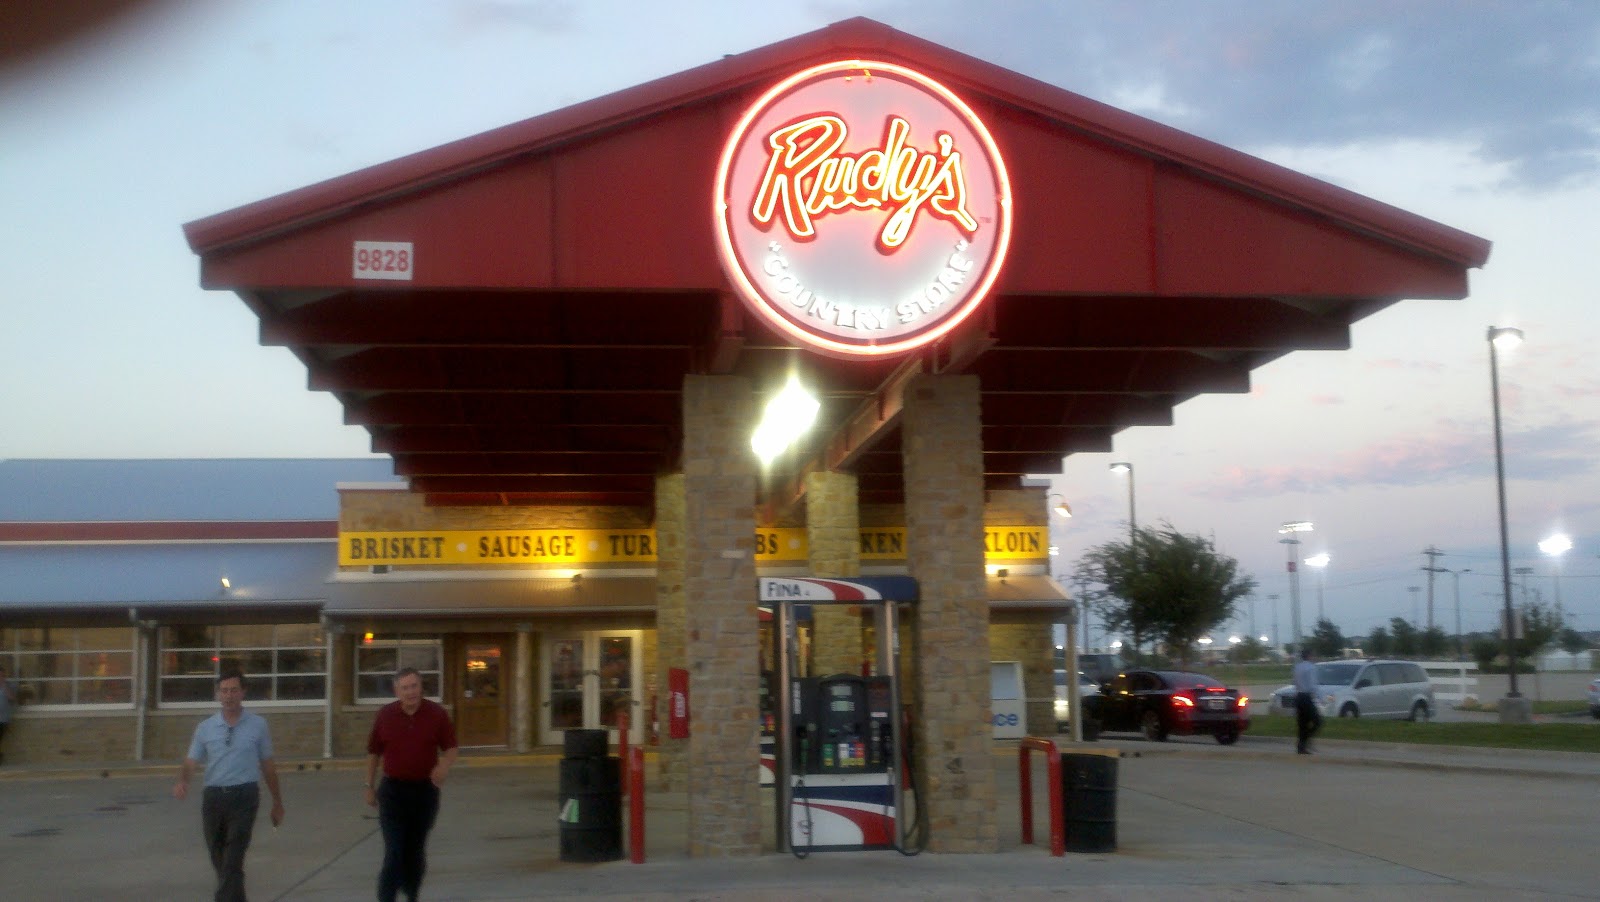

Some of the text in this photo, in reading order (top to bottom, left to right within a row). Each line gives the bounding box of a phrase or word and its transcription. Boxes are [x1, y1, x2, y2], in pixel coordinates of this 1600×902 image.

[751, 112, 978, 253] Rudy's
[358, 249, 409, 271] 9828
[350, 536, 445, 560] BRISKET
[479, 535, 576, 558] SAUSAGE
[608, 534, 657, 556] TUR
[754, 533, 778, 554] BS
[860, 532, 903, 553] KEN
[767, 581, 802, 597] FINA
